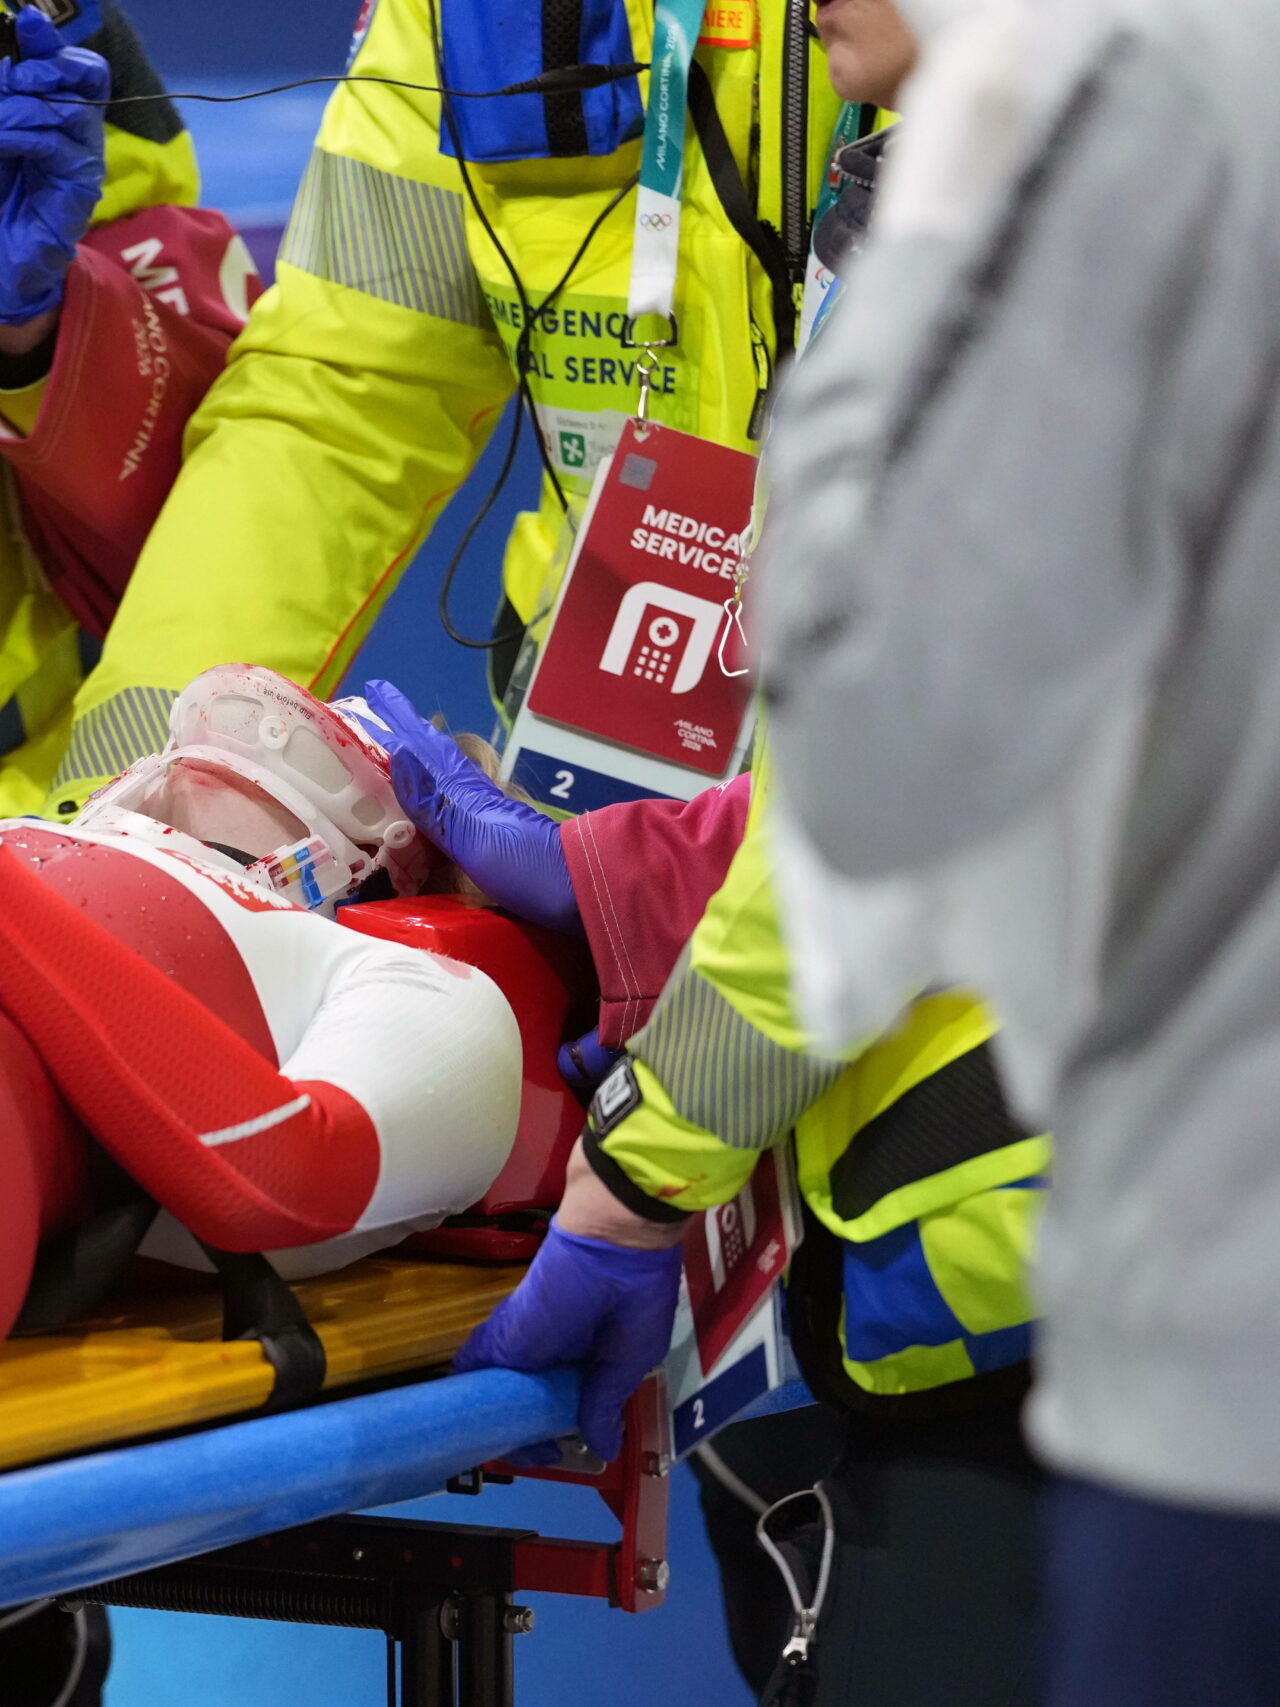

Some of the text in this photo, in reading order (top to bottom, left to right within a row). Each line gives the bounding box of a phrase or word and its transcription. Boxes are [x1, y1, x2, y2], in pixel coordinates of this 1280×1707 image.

[659, 52, 673, 112] CORTINA
[656, 113, 670, 171] MILANO
[565, 356, 676, 393] SERVICE
[642, 504, 741, 556] MEDICA
[549, 769, 575, 800] 2
[693, 1399, 705, 1429] 2
